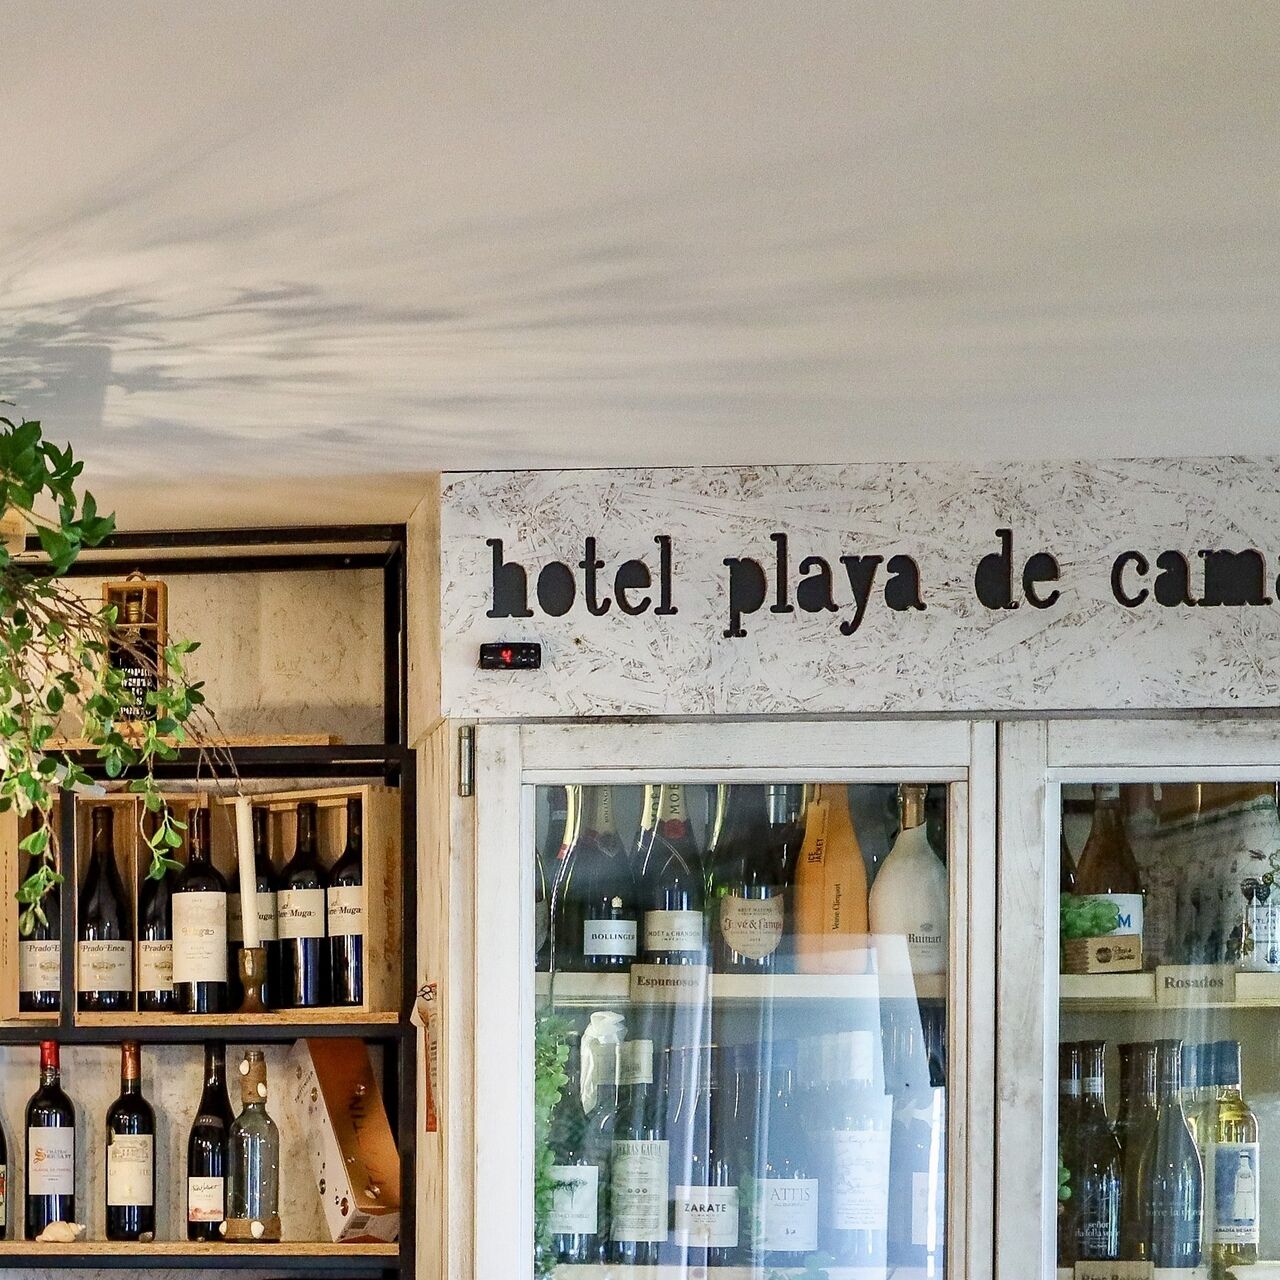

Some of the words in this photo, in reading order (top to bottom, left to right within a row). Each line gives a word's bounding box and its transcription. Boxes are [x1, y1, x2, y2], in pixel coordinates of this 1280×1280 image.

[486, 535, 679, 618] hotel
[723, 532, 928, 638] playa
[975, 529, 1061, 610] de
[1111, 549, 1280, 607] cam
[290, 908, 316, 917] Muga
[339, 906, 364, 915] Muga
[637, 976, 700, 988] Espumosos
[1164, 976, 1224, 989] Rosados
[771, 1188, 810, 1201] ATTIS
[684, 1203, 727, 1213] ZARATE
